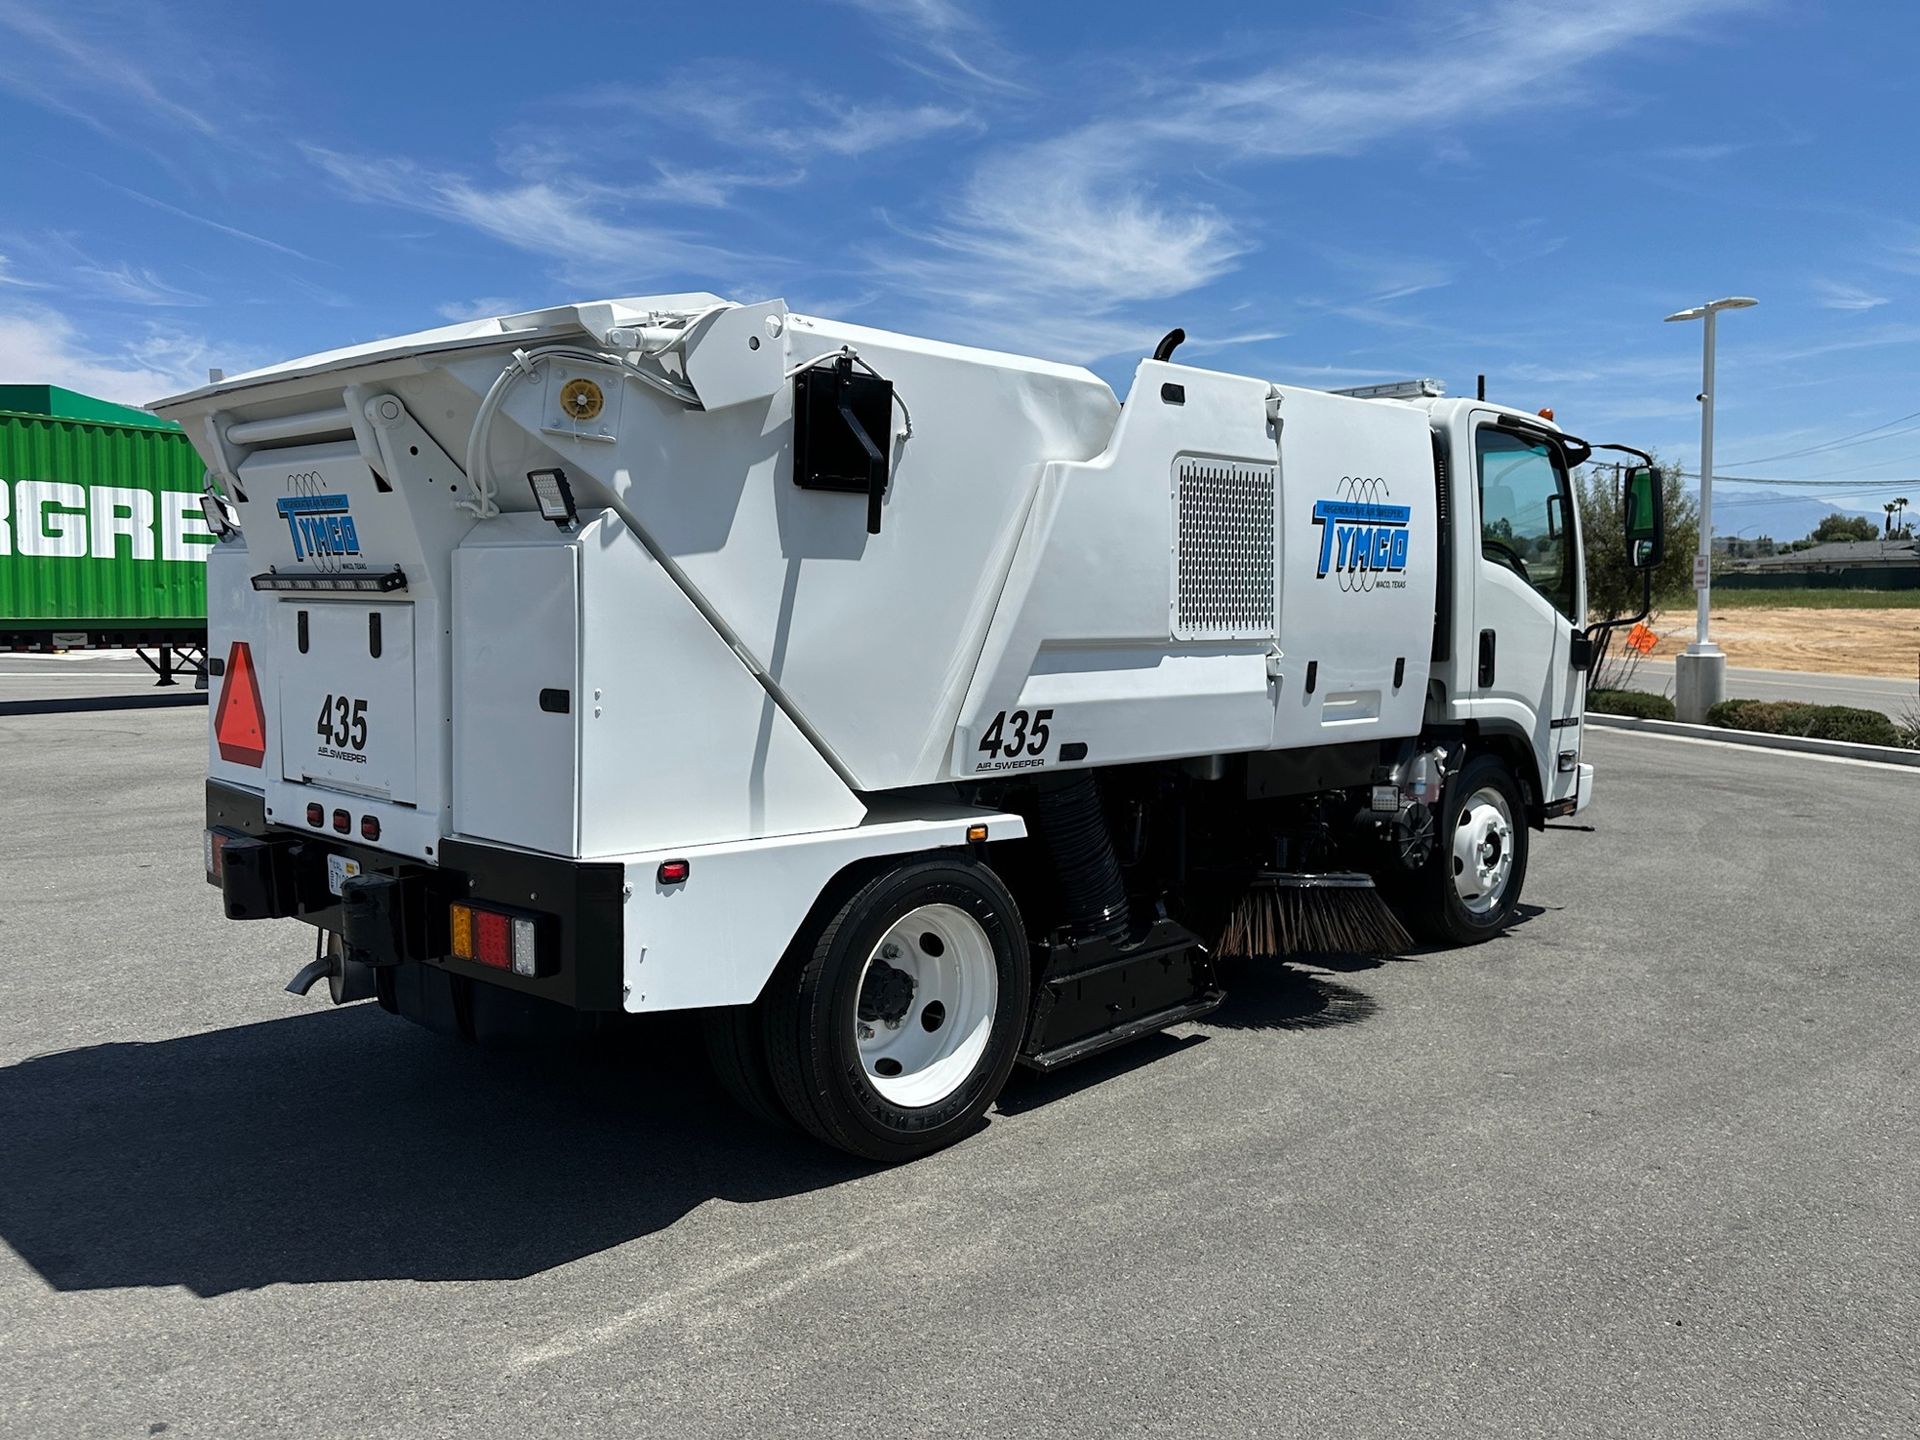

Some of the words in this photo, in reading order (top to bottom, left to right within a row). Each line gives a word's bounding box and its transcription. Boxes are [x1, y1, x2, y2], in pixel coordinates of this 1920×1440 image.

[0, 478, 240, 562] GRE
[277, 494, 360, 562] TYMCO
[1312, 500, 1410, 579] TYMCO
[1391, 581, 1406, 589] TEXAS
[317, 694, 368, 751] 435
[978, 709, 1054, 759] 435
[318, 746, 328, 754] AIR
[330, 748, 367, 764] SWEEPER
[977, 762, 991, 770] AIR
[994, 759, 1045, 770] SWEEPER
